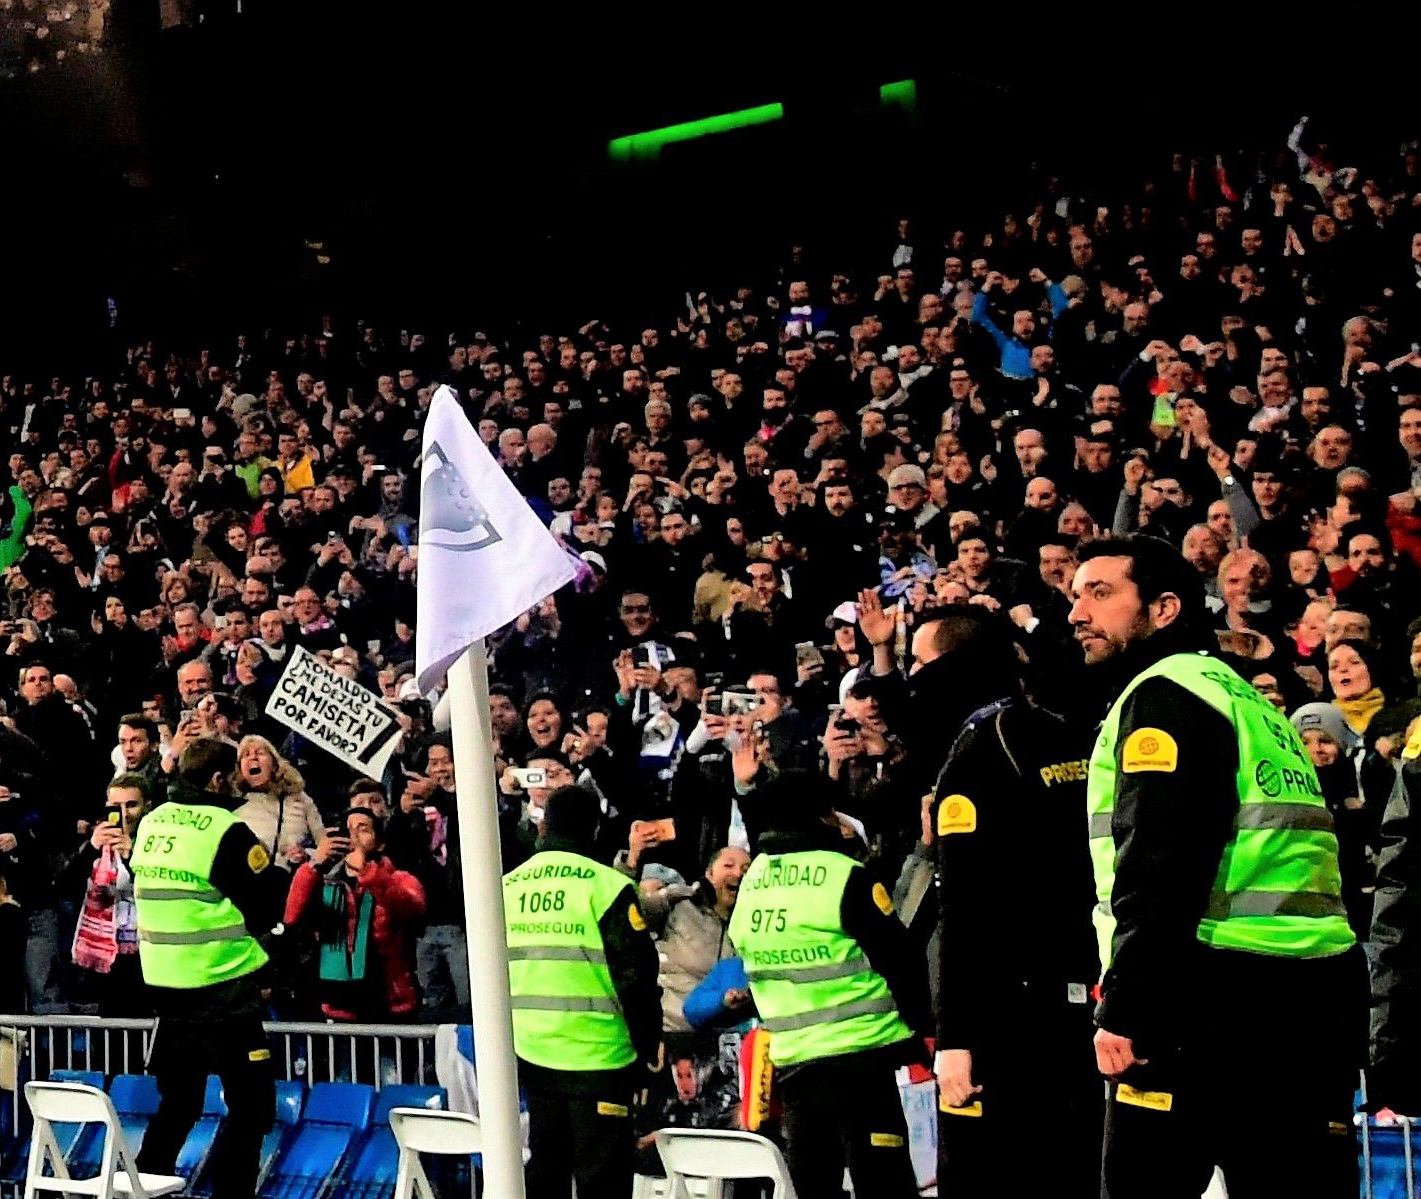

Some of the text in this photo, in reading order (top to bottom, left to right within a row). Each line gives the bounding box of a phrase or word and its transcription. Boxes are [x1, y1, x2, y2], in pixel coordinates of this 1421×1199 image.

[300, 653, 371, 703] RONALDO
[274, 698, 307, 725] POR
[282, 678, 366, 741] CAMISETA
[321, 683, 364, 715] DEJAS
[366, 710, 383, 727] TU
[143, 835, 176, 854] 875
[519, 890, 565, 913] 1068
[510, 922, 585, 936] PROSEGUR
[750, 909, 787, 933] 975
